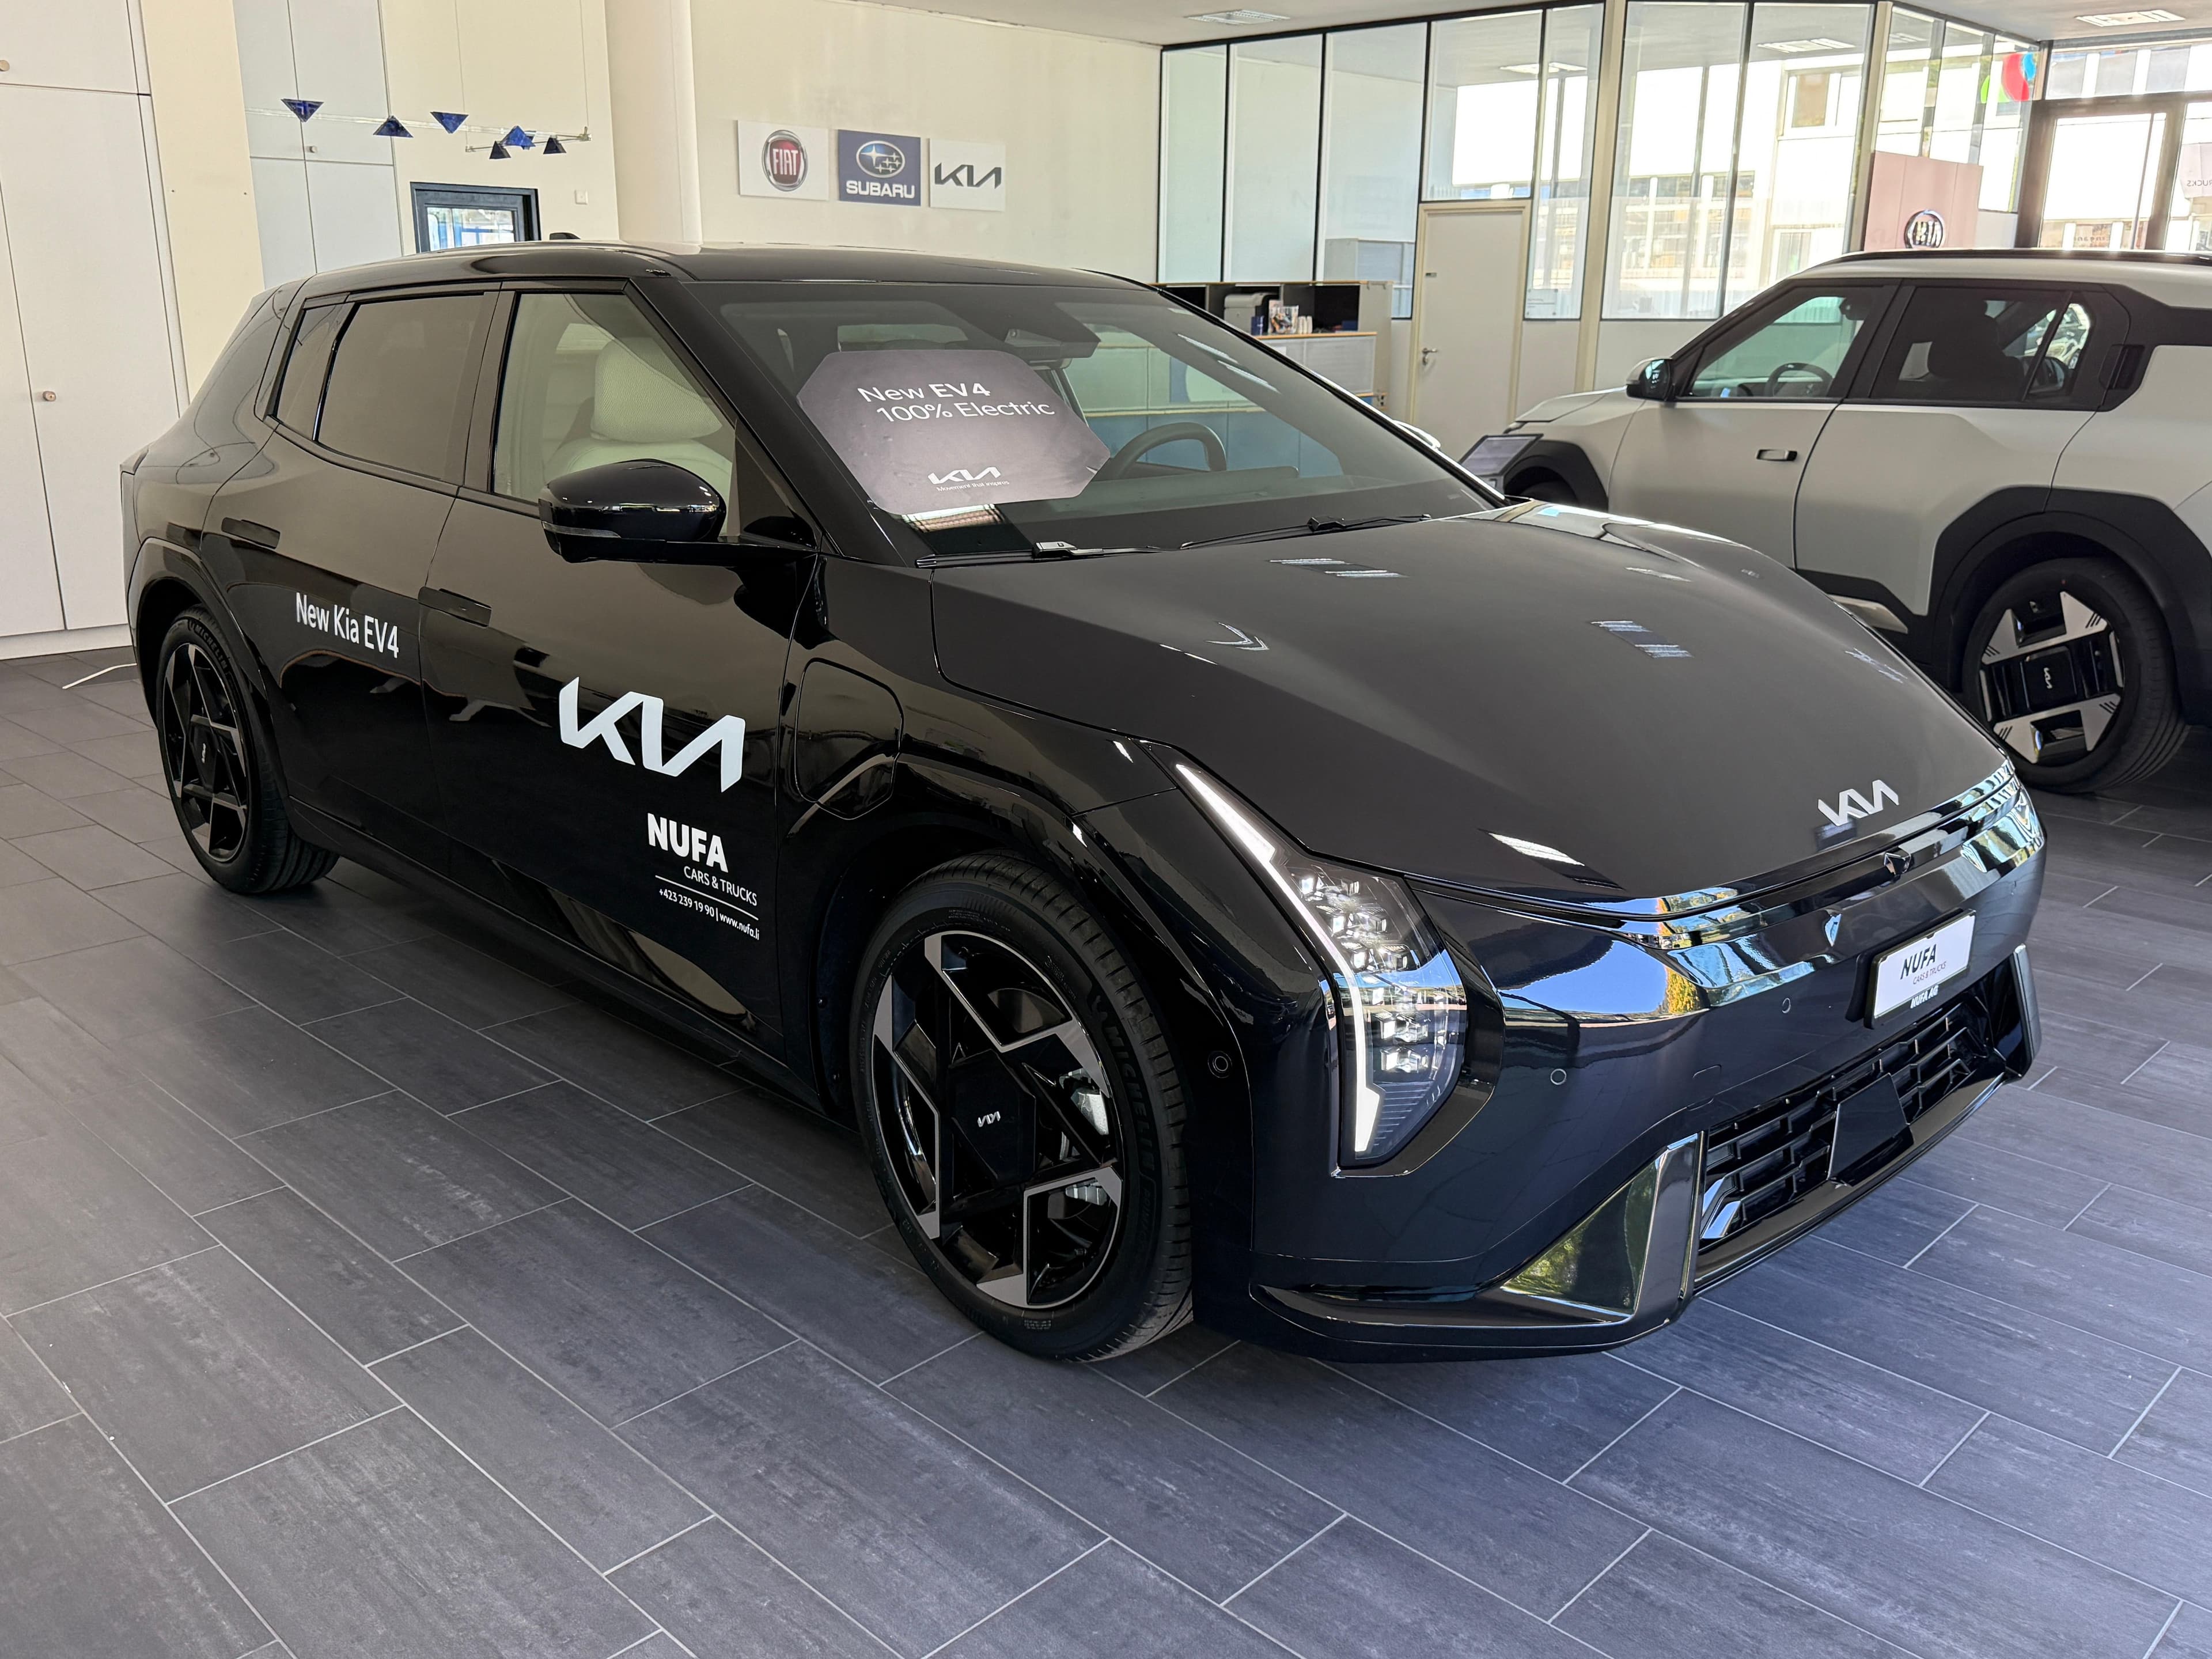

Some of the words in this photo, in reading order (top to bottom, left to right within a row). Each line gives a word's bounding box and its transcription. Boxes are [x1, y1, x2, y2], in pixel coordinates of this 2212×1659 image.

[772, 149, 799, 175] FIAT
[934, 162, 1002, 190] KIA
[846, 180, 915, 199] SUBARU
[857, 385, 925, 403] New
[928, 382, 991, 398] EV4
[876, 404, 953, 423] 100%
[957, 400, 1055, 418] Electric
[927, 466, 1001, 484] KIA
[935, 484, 971, 492] Movement
[296, 592, 330, 632] New
[334, 604, 359, 644] Kia
[363, 615, 400, 659] EV4
[559, 676, 745, 793] KIA
[1818, 779, 1899, 827] KIA
[647, 812, 729, 873] NUFA
[683, 865, 710, 886] CARS
[711, 876, 719, 889] &
[719, 878, 757, 907] TRUCKS
[659, 888, 678, 903] +423
[678, 893, 692, 908] 239
[694, 900, 703, 912] 19
[704, 904, 715, 917] 90
[719, 912, 760, 941] www.nufa.li
[1900, 944, 1937, 980] NUFA
[1910, 990, 1928, 1009] NUFA
[1928, 984, 1939, 999] AG
